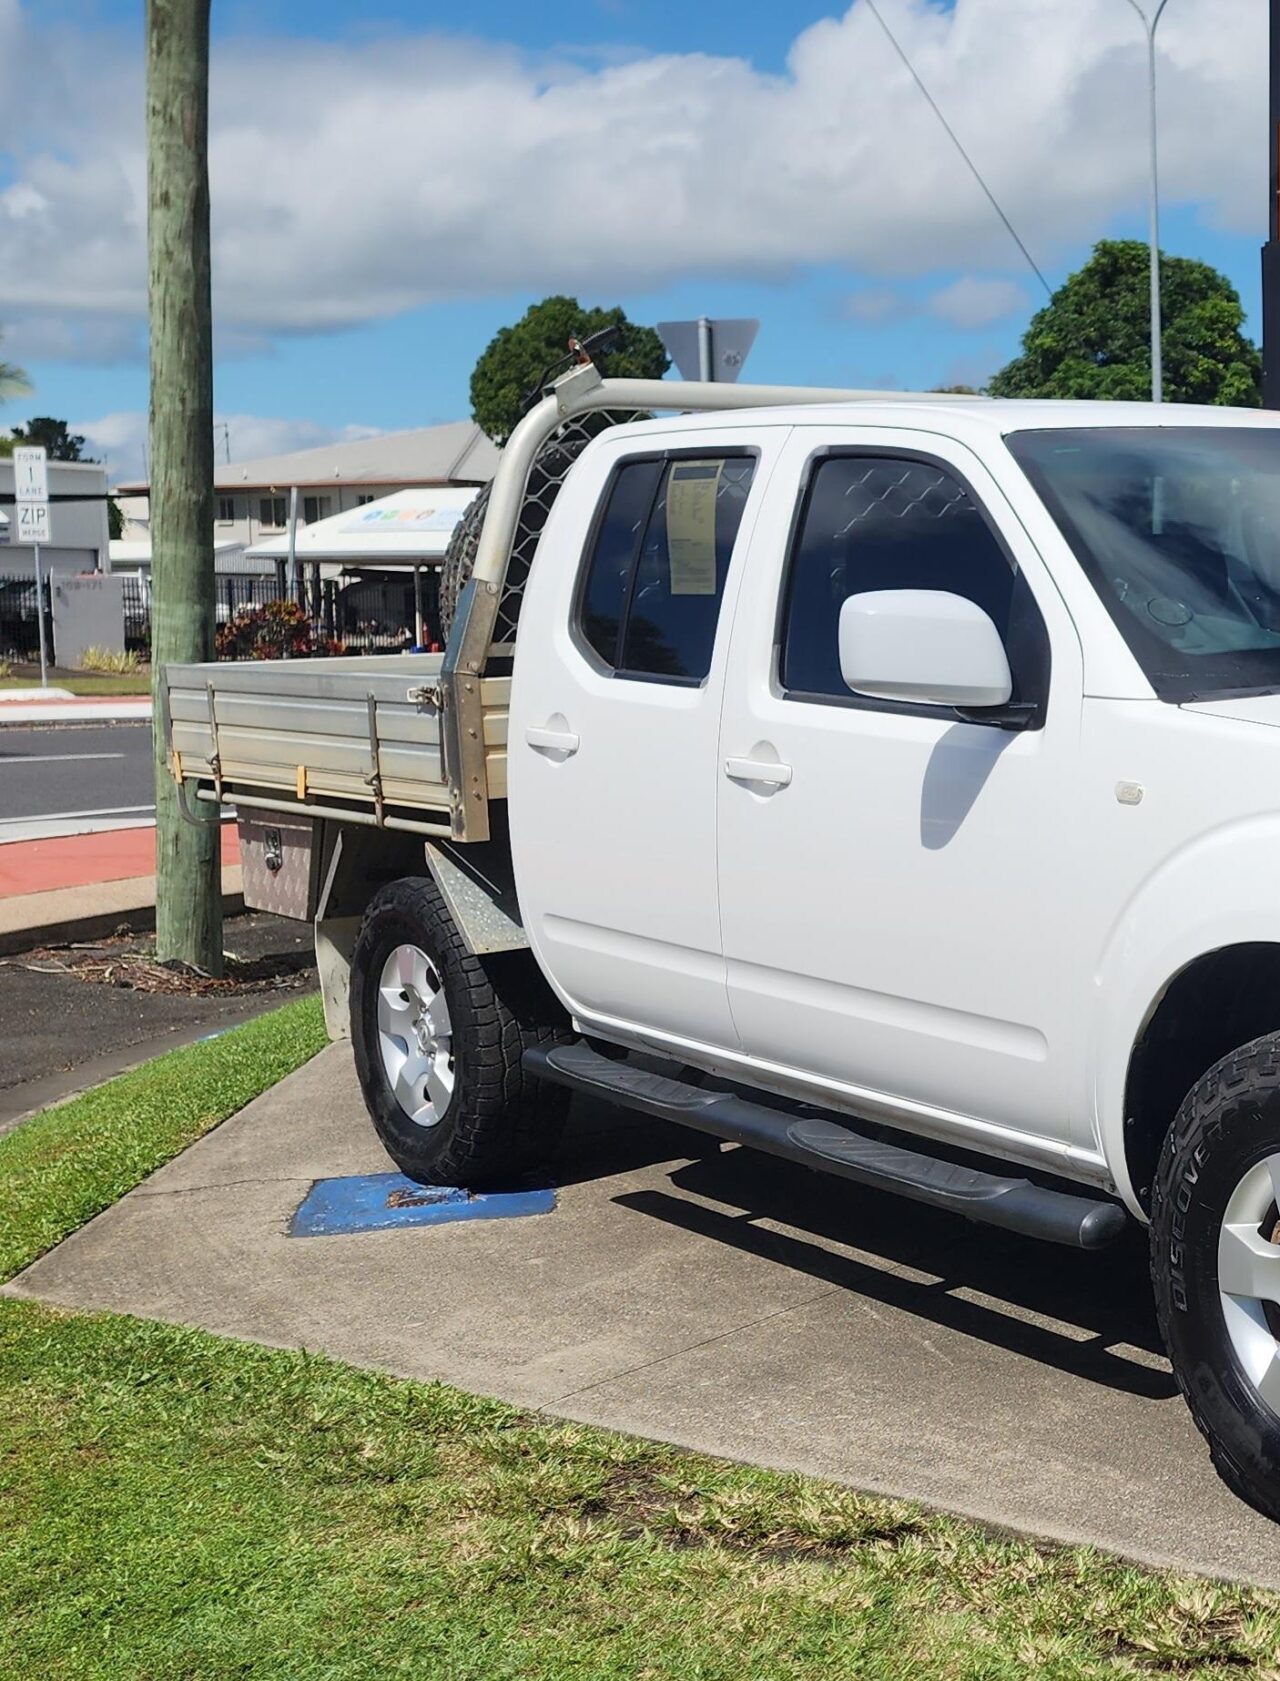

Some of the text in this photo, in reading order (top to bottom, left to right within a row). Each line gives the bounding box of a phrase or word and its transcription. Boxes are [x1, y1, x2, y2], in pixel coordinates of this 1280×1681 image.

[28, 466, 34, 482] 1
[19, 486, 43, 497] LANE
[20, 508, 46, 525] ZIP
